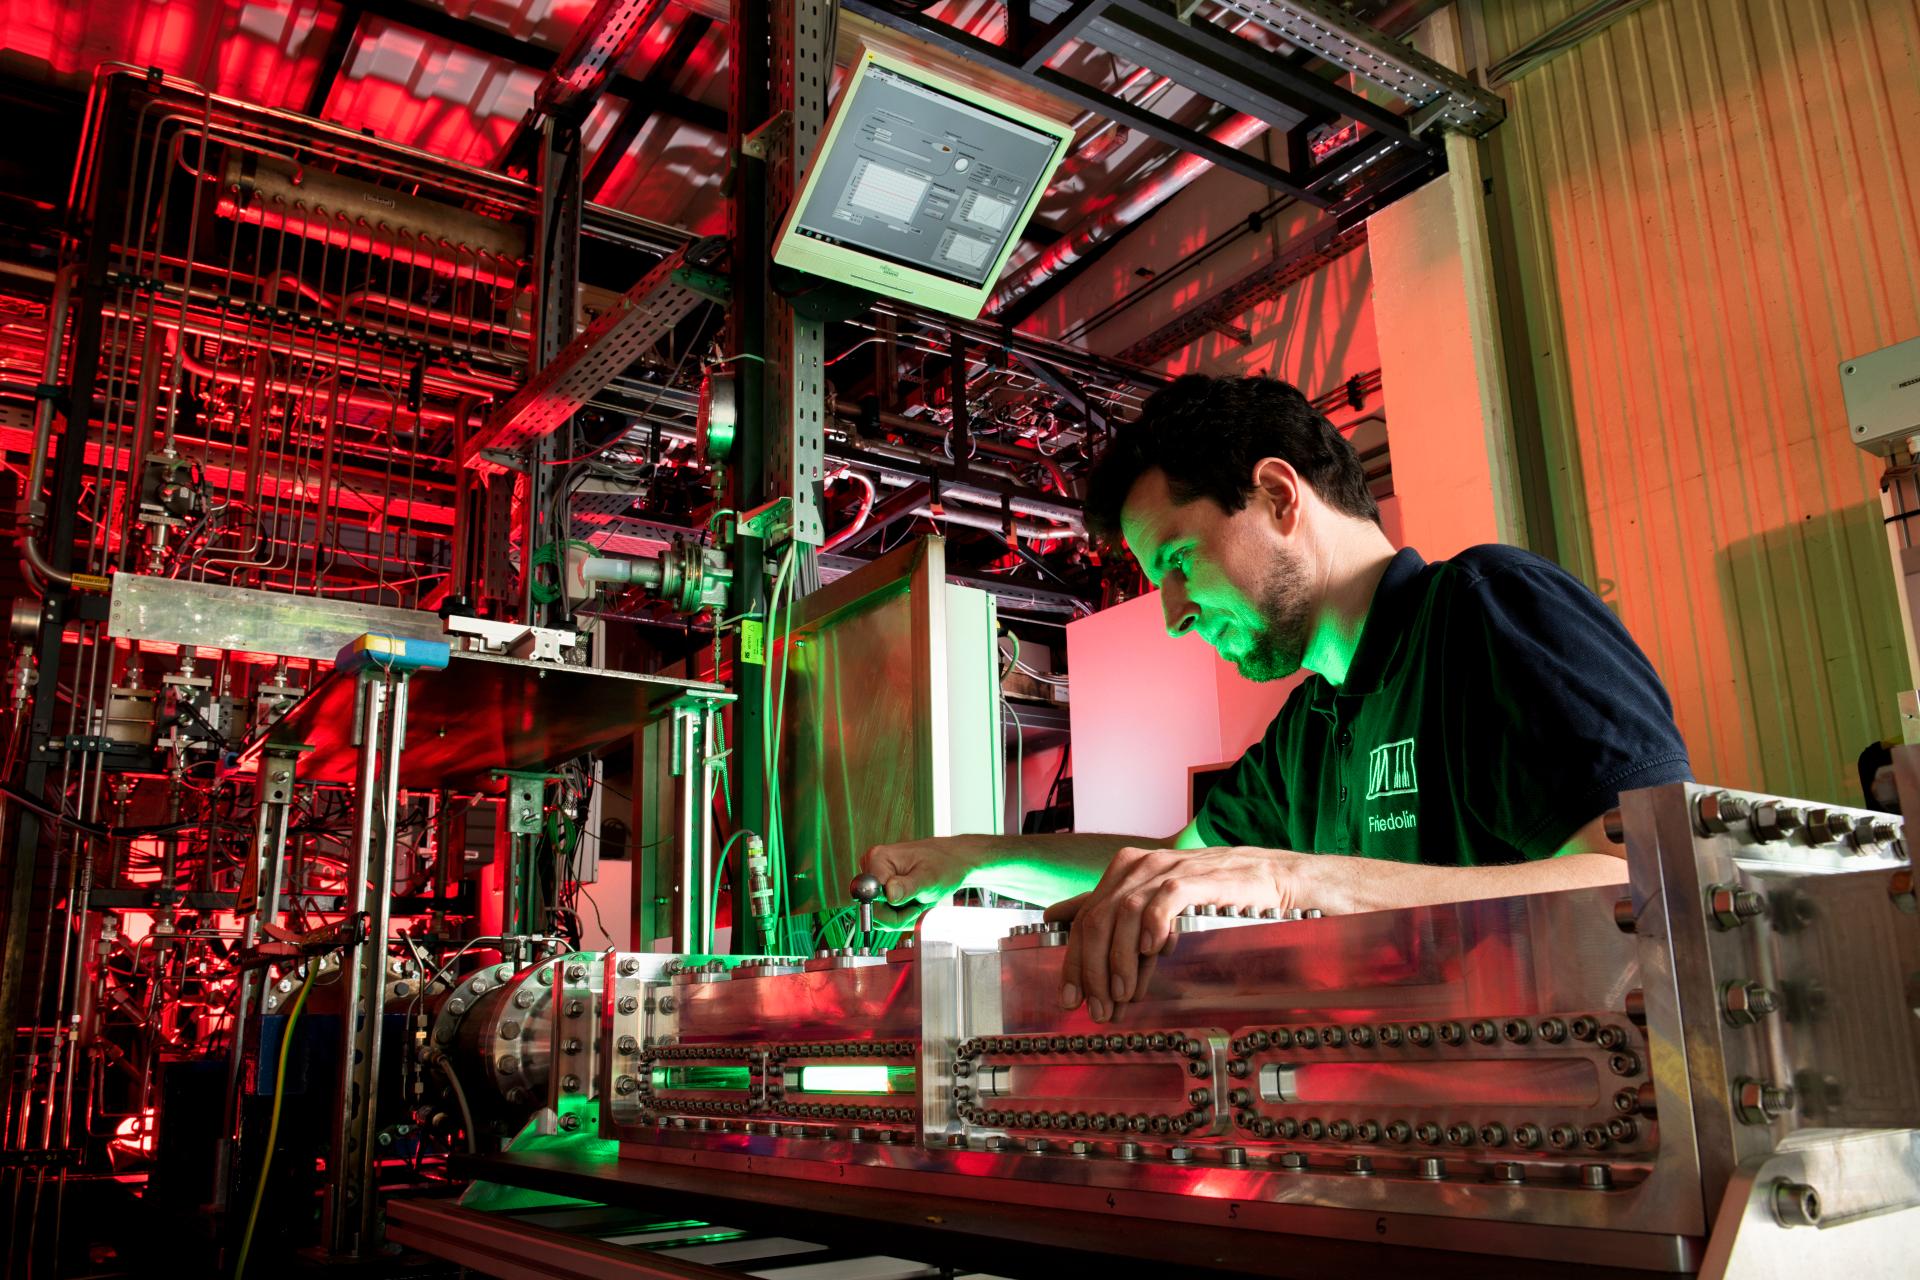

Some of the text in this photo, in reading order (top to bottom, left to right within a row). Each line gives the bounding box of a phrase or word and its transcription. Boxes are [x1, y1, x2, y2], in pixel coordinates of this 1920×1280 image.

[1369, 810, 1416, 832] Friedolin
[839, 1165, 844, 1177] 3
[1106, 1192, 1115, 1208] 4
[1228, 1204, 1240, 1219] 5
[1375, 1217, 1387, 1235] 6
